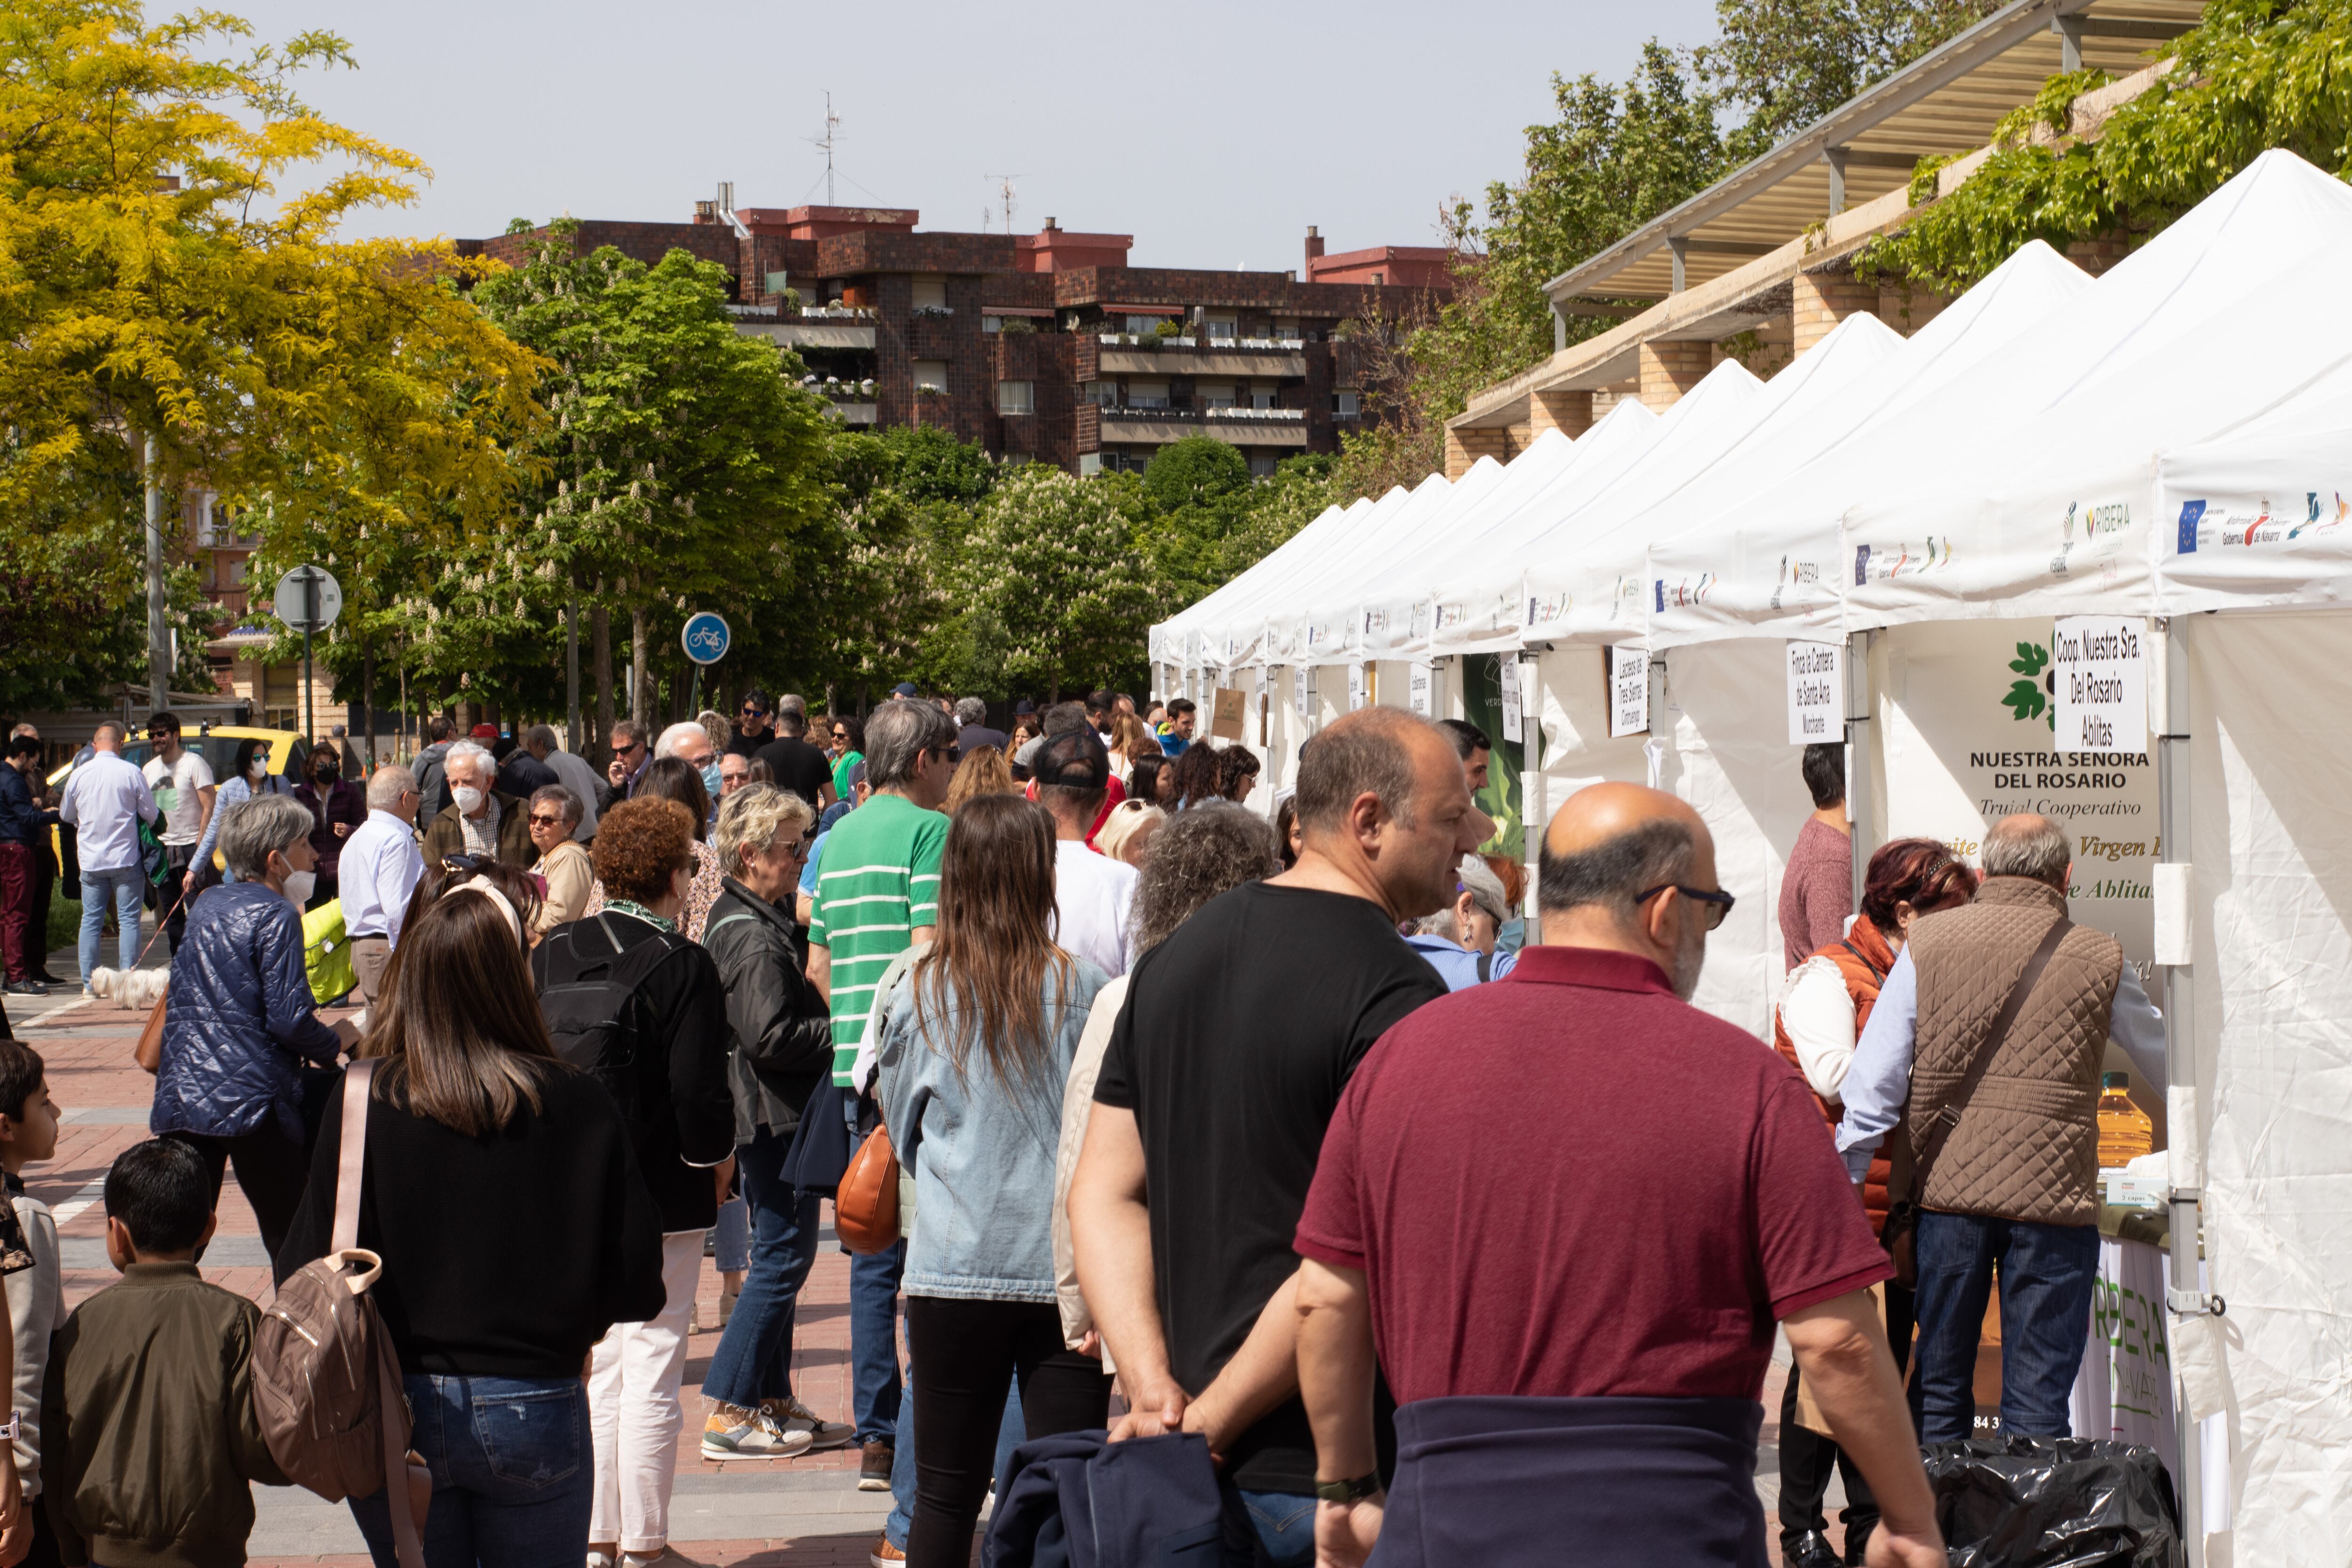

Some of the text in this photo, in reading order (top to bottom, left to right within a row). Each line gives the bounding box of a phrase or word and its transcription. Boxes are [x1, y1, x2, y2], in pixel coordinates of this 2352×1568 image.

[2096, 503, 2130, 534] RIBERA
[2222, 531, 2280, 546] Gobernua de Navarra
[1799, 562, 1819, 584] RIBERA
[2057, 626, 2140, 670] Coop. Nuestra Sra.
[1620, 657, 1636, 679] Lácteos
[1792, 647, 1834, 676] Finca la Cantera
[1619, 681, 1642, 705] Tres Sierras
[1797, 679, 1830, 707] de Santa Ana
[2071, 671, 2122, 704] Del Rosario
[1485, 698, 1502, 707] VERD
[1621, 707, 1640, 727] Cintruénigo
[1803, 713, 1825, 734] Murchante
[2082, 715, 2113, 747] Ablitas
[1971, 752, 2062, 768] NUESTRA
[1994, 773, 2126, 788] DEL ROSARIO
[2036, 799, 2141, 819] Cooperativo
[2080, 836, 2145, 861] Virgen
[2085, 879, 2153, 899] Ablita
